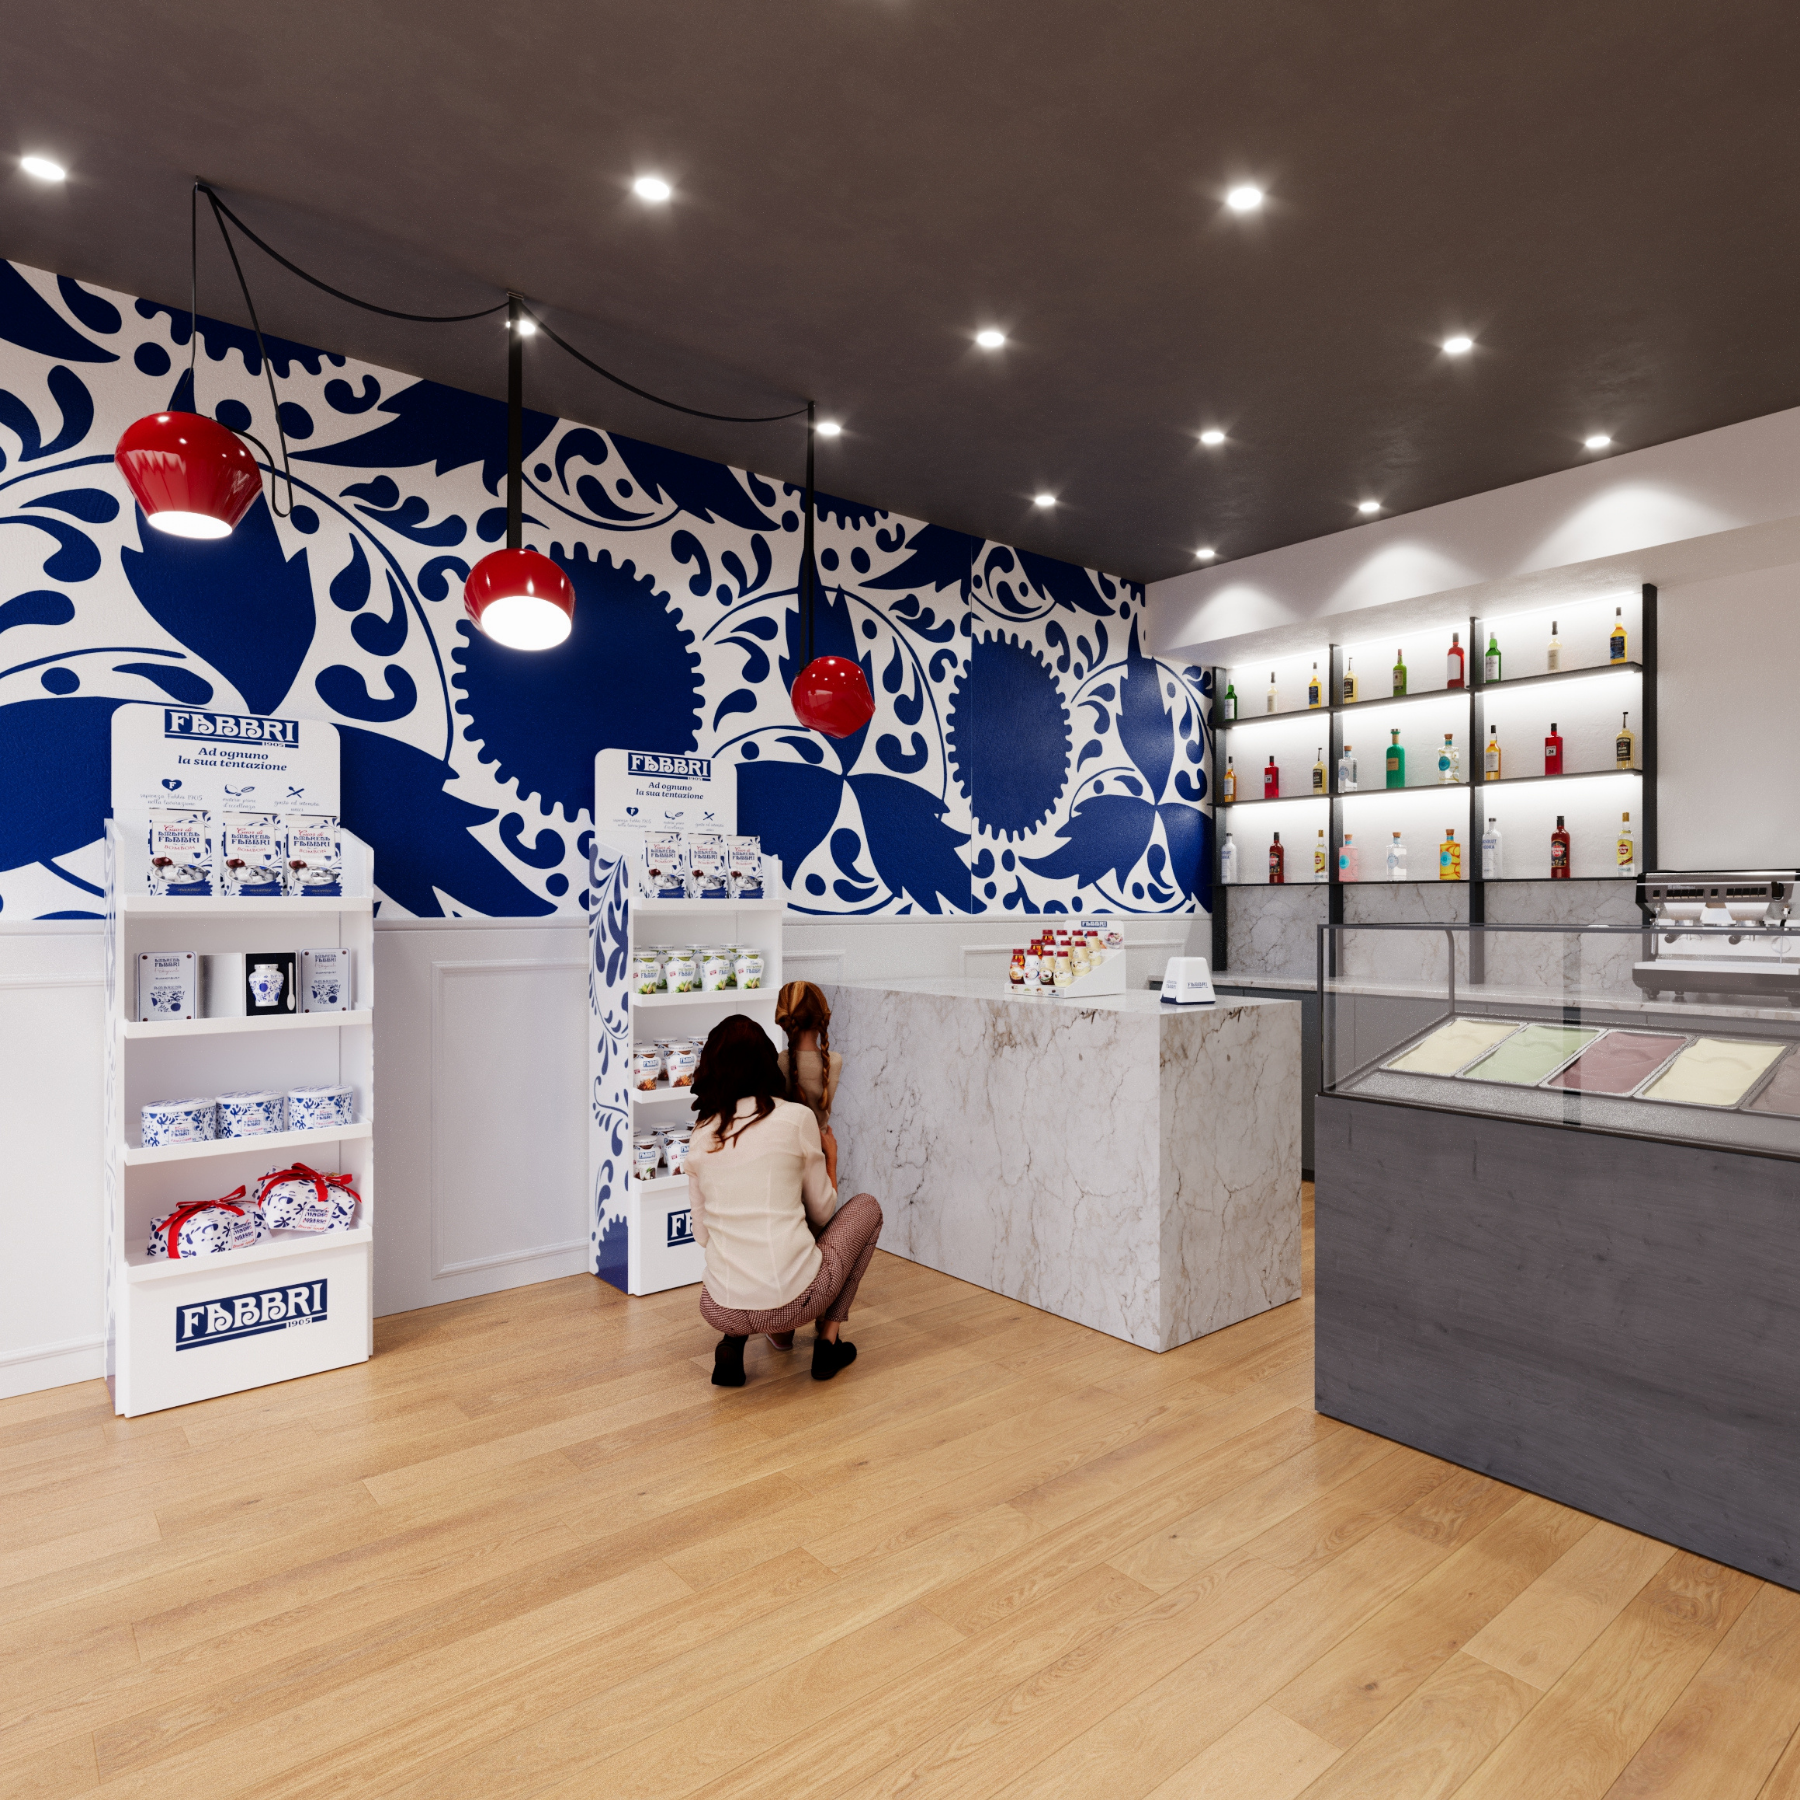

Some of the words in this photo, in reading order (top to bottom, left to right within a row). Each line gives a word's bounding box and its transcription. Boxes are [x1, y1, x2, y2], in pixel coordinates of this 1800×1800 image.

[169, 711, 295, 742] FABBRI
[198, 747, 218, 757] Ad
[219, 749, 269, 761] ognuno
[178, 755, 191, 765] la
[193, 757, 218, 767] sua
[219, 759, 288, 771] tentazione
[630, 754, 709, 777] FABBRI
[648, 781, 661, 790] Ad
[661, 783, 693, 791] ognuno
[636, 788, 645, 796] la
[661, 791, 704, 800] tentazione
[181, 1282, 324, 1340] FABBRI
[287, 1317, 312, 1328] 1905
